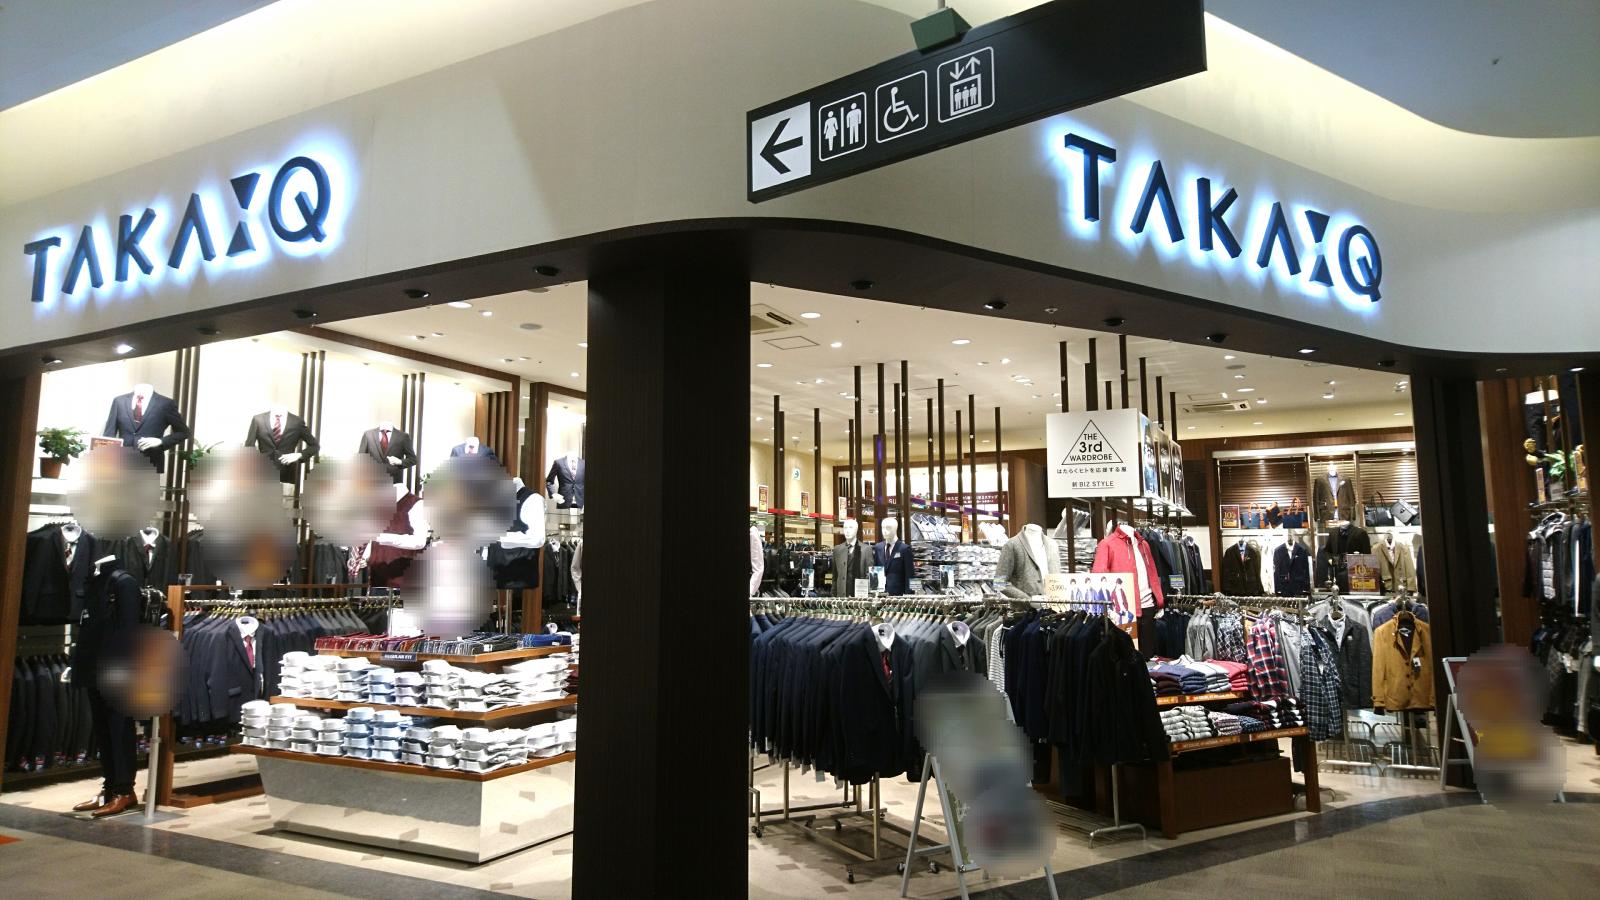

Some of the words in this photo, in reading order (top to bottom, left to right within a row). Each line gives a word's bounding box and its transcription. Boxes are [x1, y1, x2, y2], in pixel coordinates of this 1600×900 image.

[1083, 433, 1098, 441] THE
[1079, 441, 1103, 453] 3rd
[1069, 453, 1113, 462] WARDROBE
